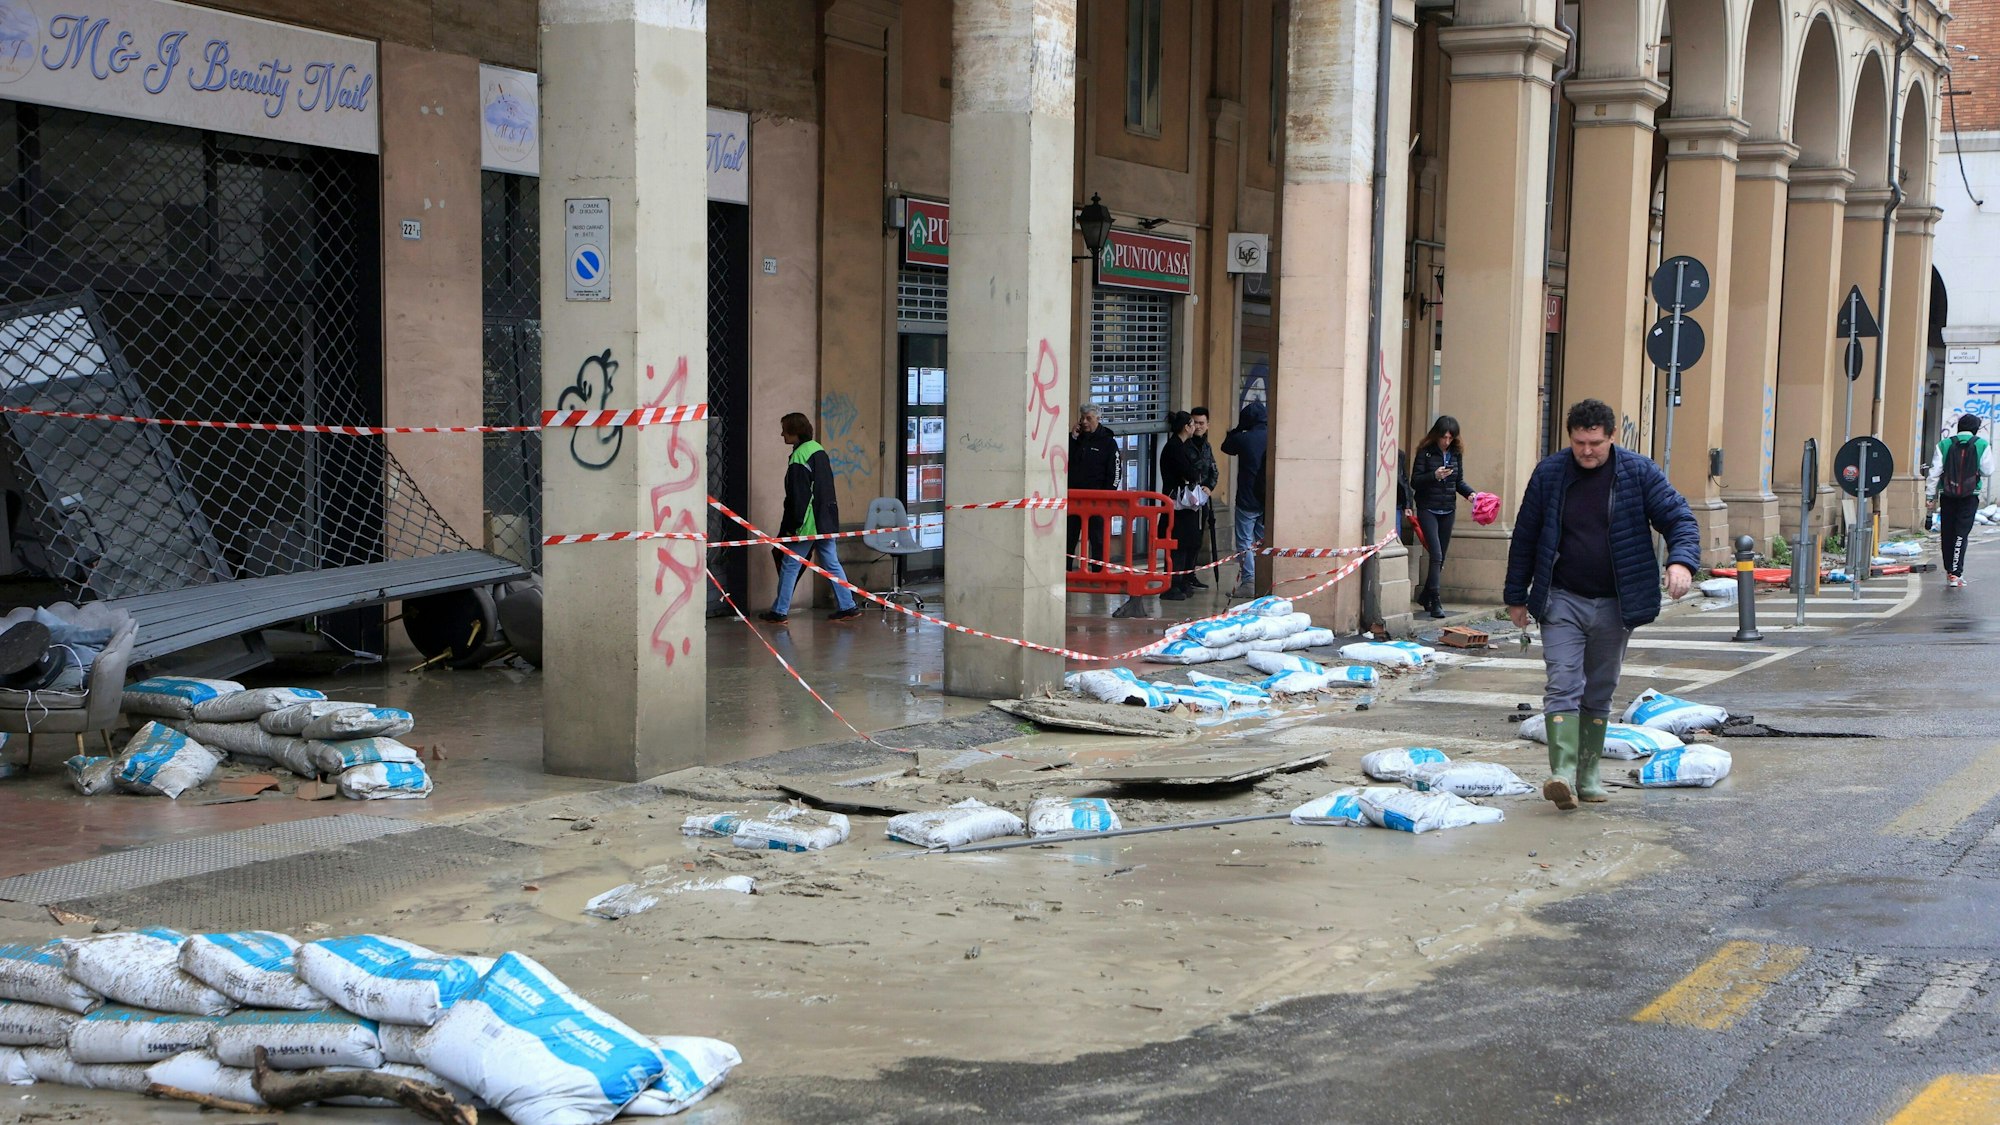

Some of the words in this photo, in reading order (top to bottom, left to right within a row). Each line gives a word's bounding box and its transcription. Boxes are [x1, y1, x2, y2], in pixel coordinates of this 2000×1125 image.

[187, 39, 292, 118] Beauty
[298, 61, 373, 112] Nail
[1115, 243, 1189, 276] PUNTOCASA
[1955, 535, 1963, 547] AIR
